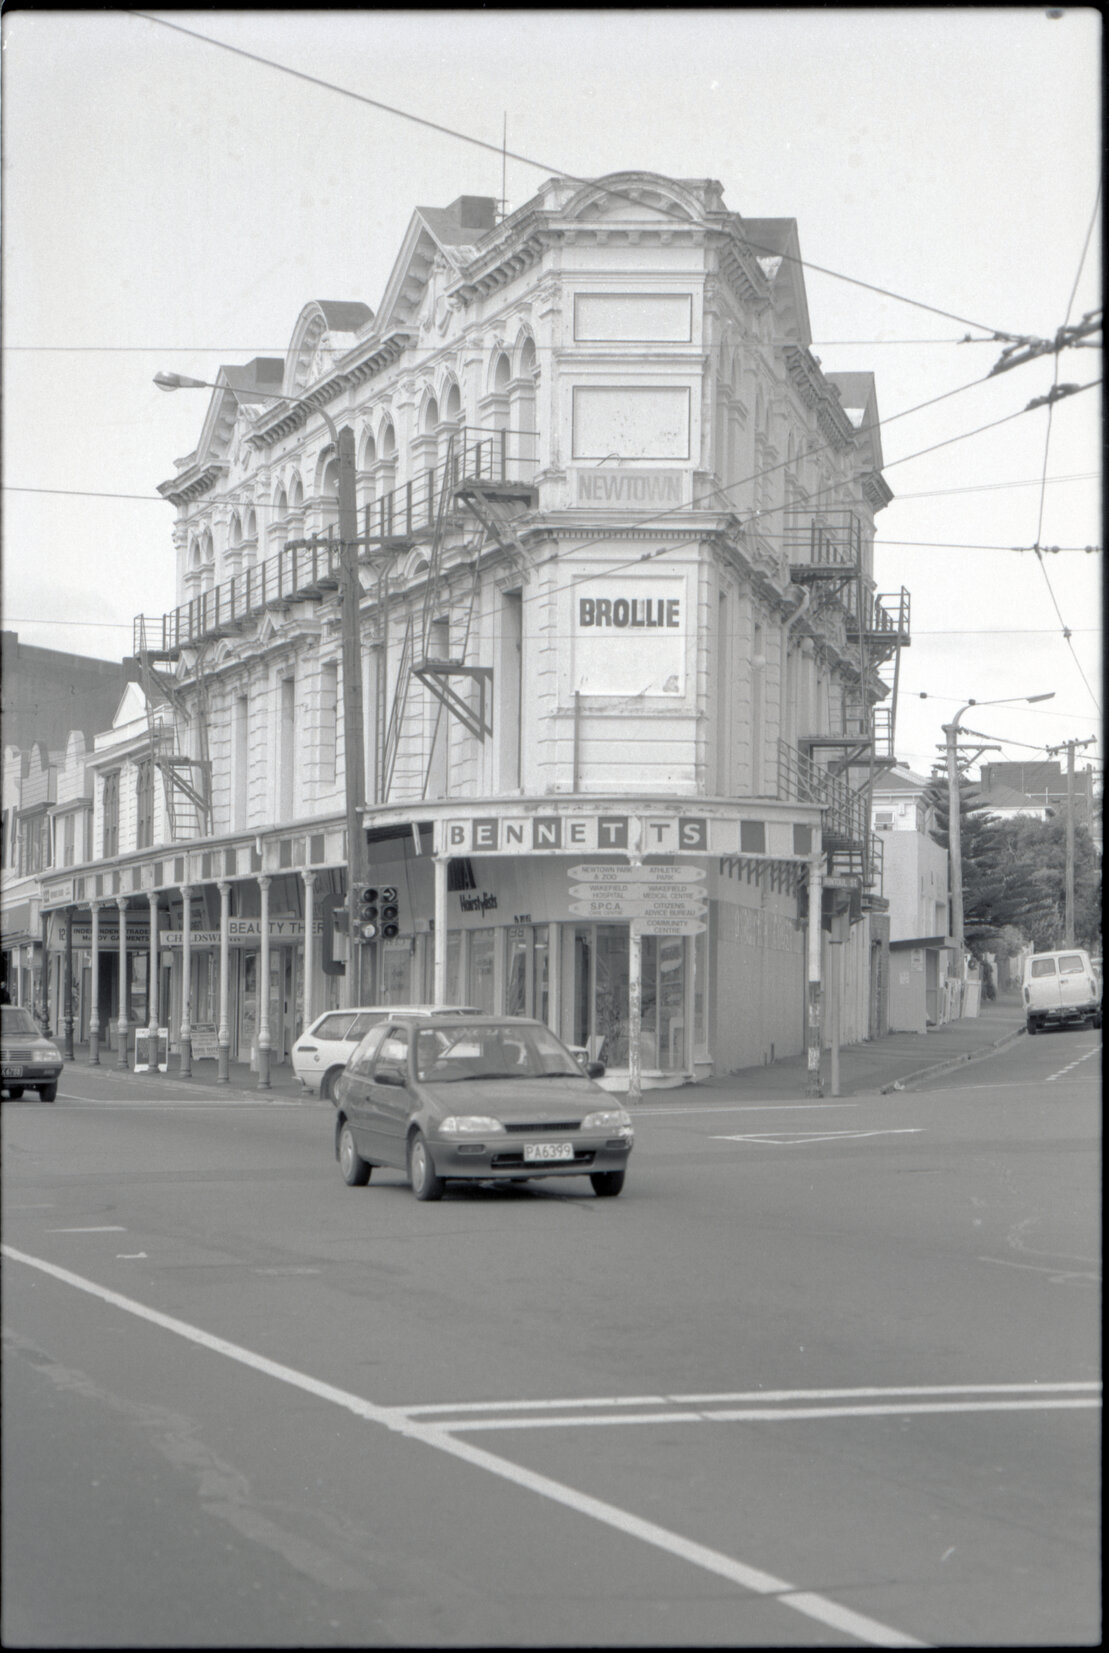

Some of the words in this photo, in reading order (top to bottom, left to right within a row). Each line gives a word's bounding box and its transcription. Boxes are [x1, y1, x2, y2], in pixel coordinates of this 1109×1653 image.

[578, 475, 682, 500] NEWTOWN
[579, 598, 680, 627] BROLLIE
[450, 822, 701, 846] BENNETTS
[229, 922, 284, 934] BEAUTY
[526, 1144, 571, 1159] PA6399
